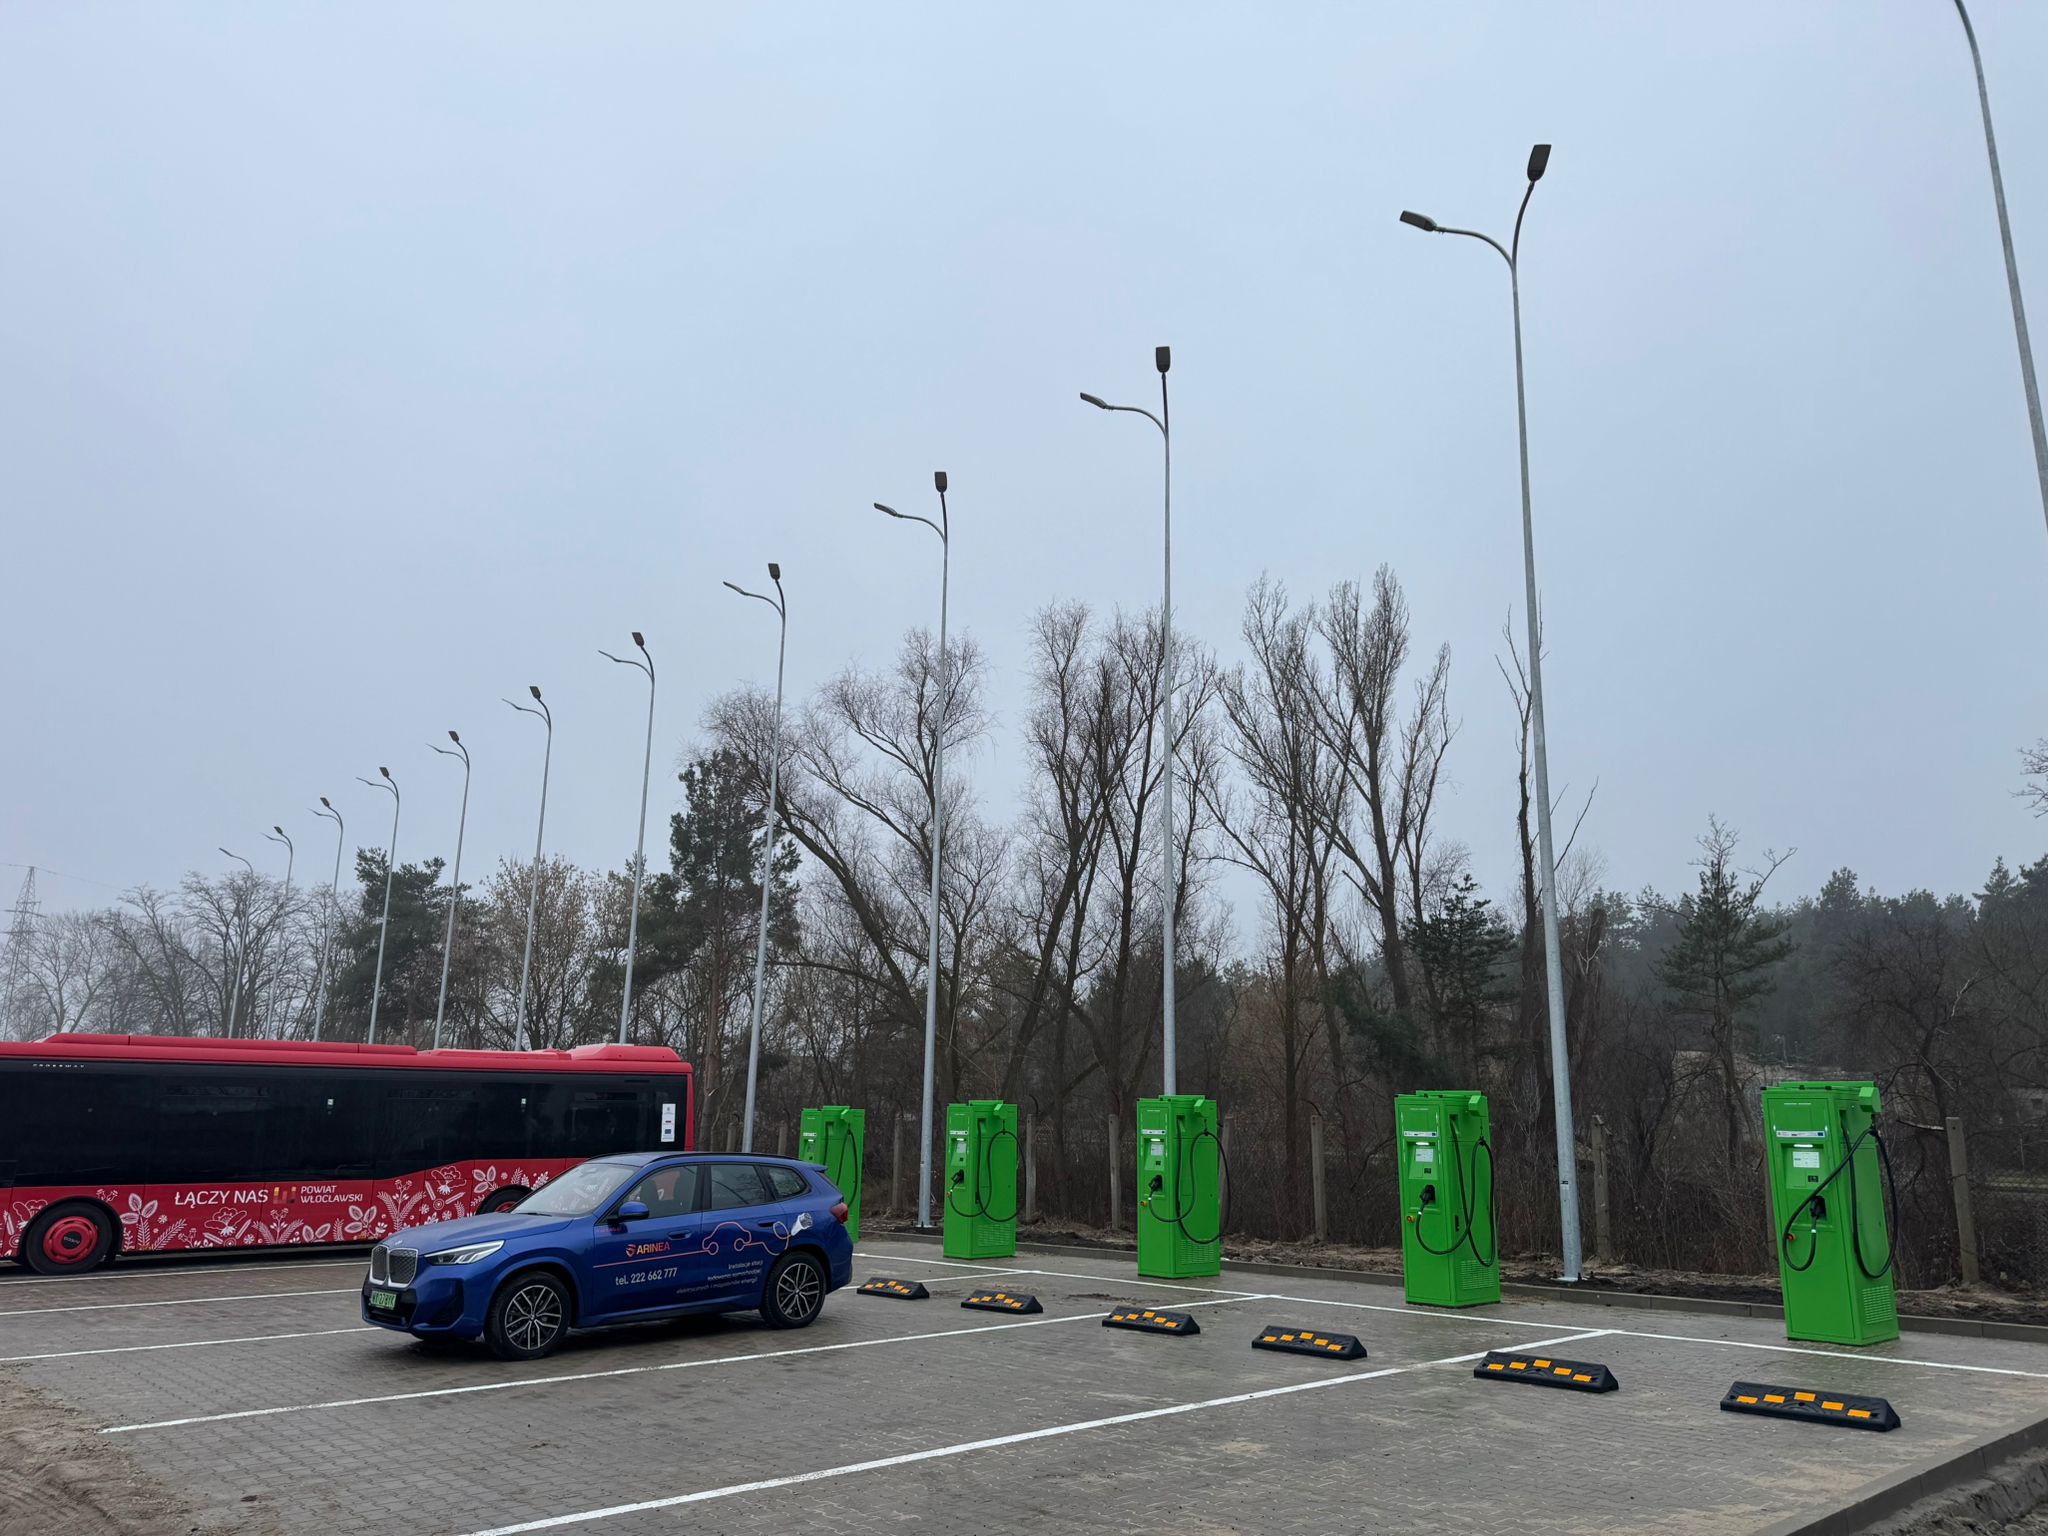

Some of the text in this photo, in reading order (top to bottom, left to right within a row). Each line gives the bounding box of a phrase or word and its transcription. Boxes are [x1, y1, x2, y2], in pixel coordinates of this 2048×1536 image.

[300, 1185, 337, 1194] POWIAT
[175, 1189, 269, 1208] ŁĄCZY NAS
[636, 1241, 671, 1255] ARINEA
[615, 1267, 678, 1286] tel. 222 662 777
